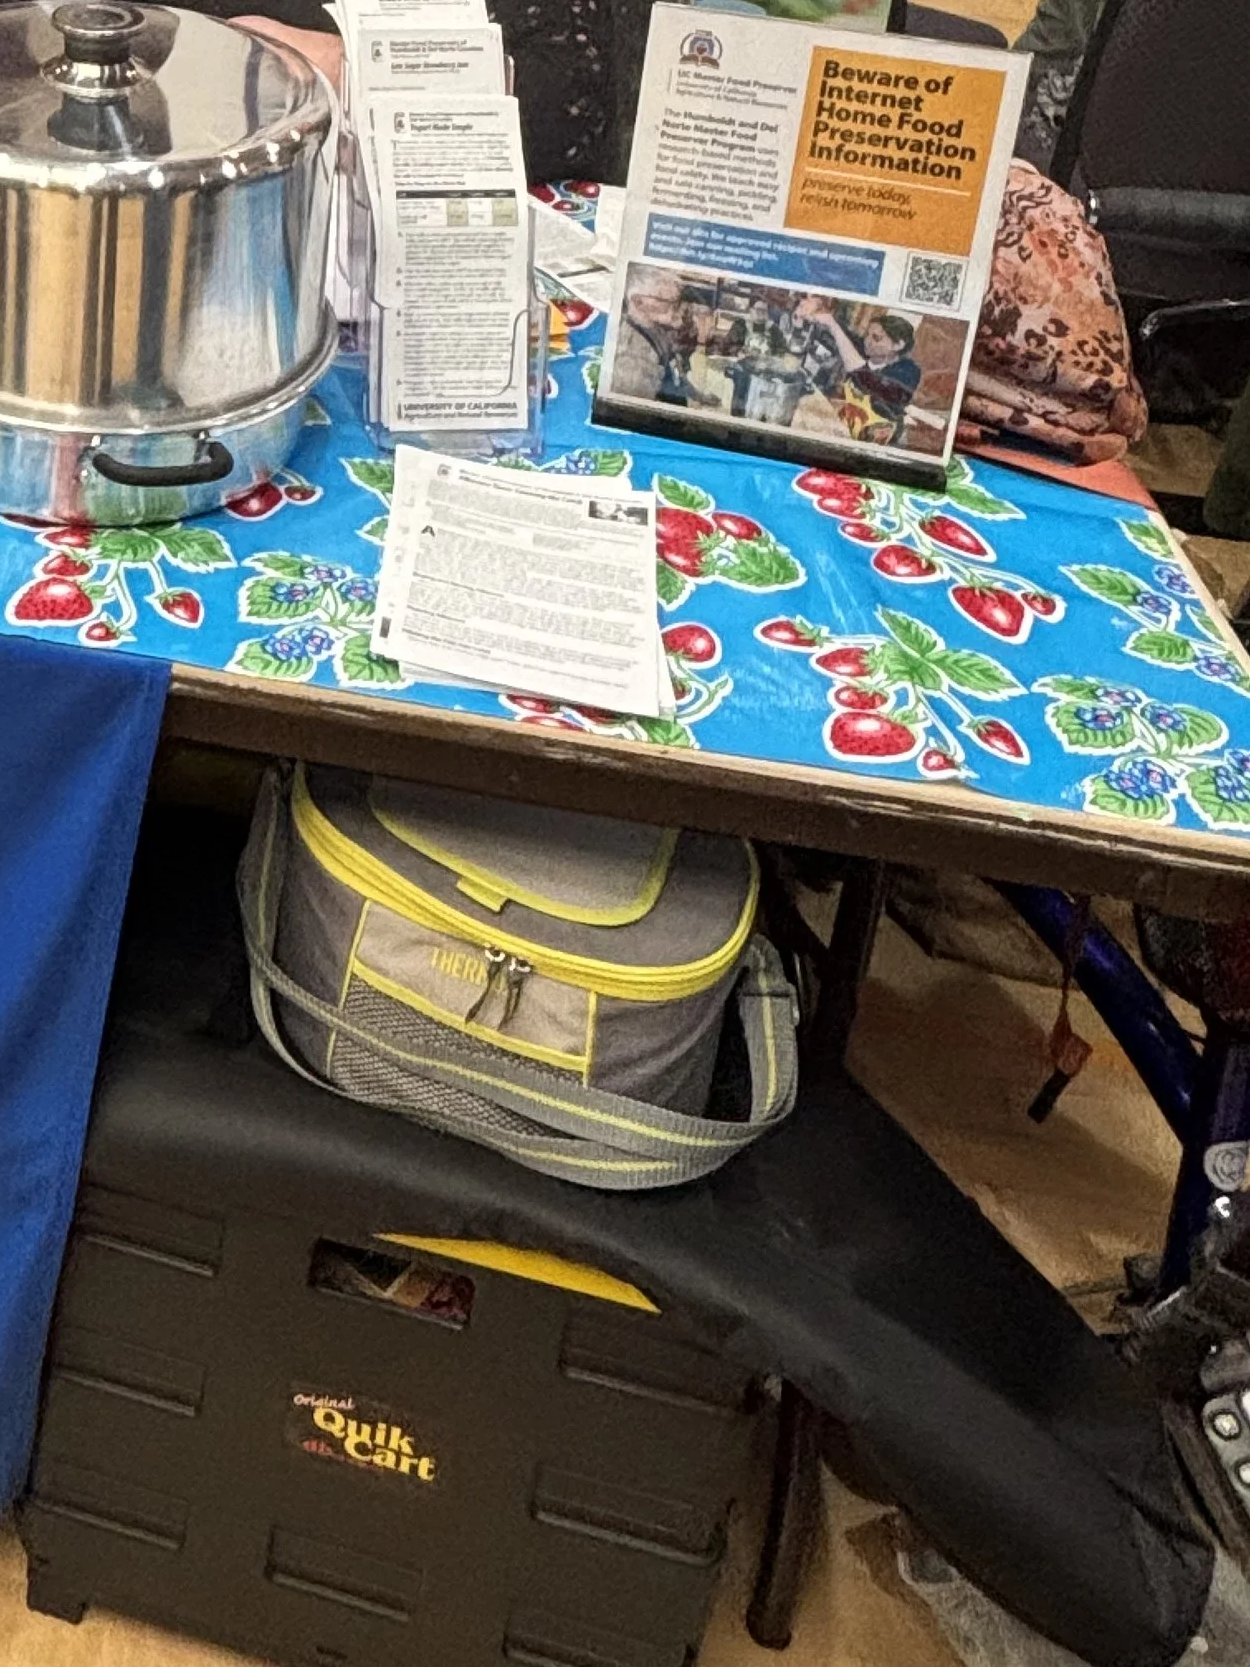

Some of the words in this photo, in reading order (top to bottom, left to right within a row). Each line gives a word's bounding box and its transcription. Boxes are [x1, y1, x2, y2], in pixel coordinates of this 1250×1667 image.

[823, 59, 919, 91] Beware
[924, 76, 954, 95] of
[820, 80, 924, 112] Internet
[816, 100, 892, 128] Home
[897, 112, 964, 138] Food
[813, 120, 976, 162] Preservation
[809, 140, 962, 180] Information
[800, 193, 839, 210] relish
[842, 198, 917, 220] tomorrow
[801, 177, 865, 196] preserve
[867, 184, 912, 205] today,
[293, 1392, 356, 1411] Original
[313, 1406, 416, 1457] Quik
[343, 1435, 436, 1482] Cart
